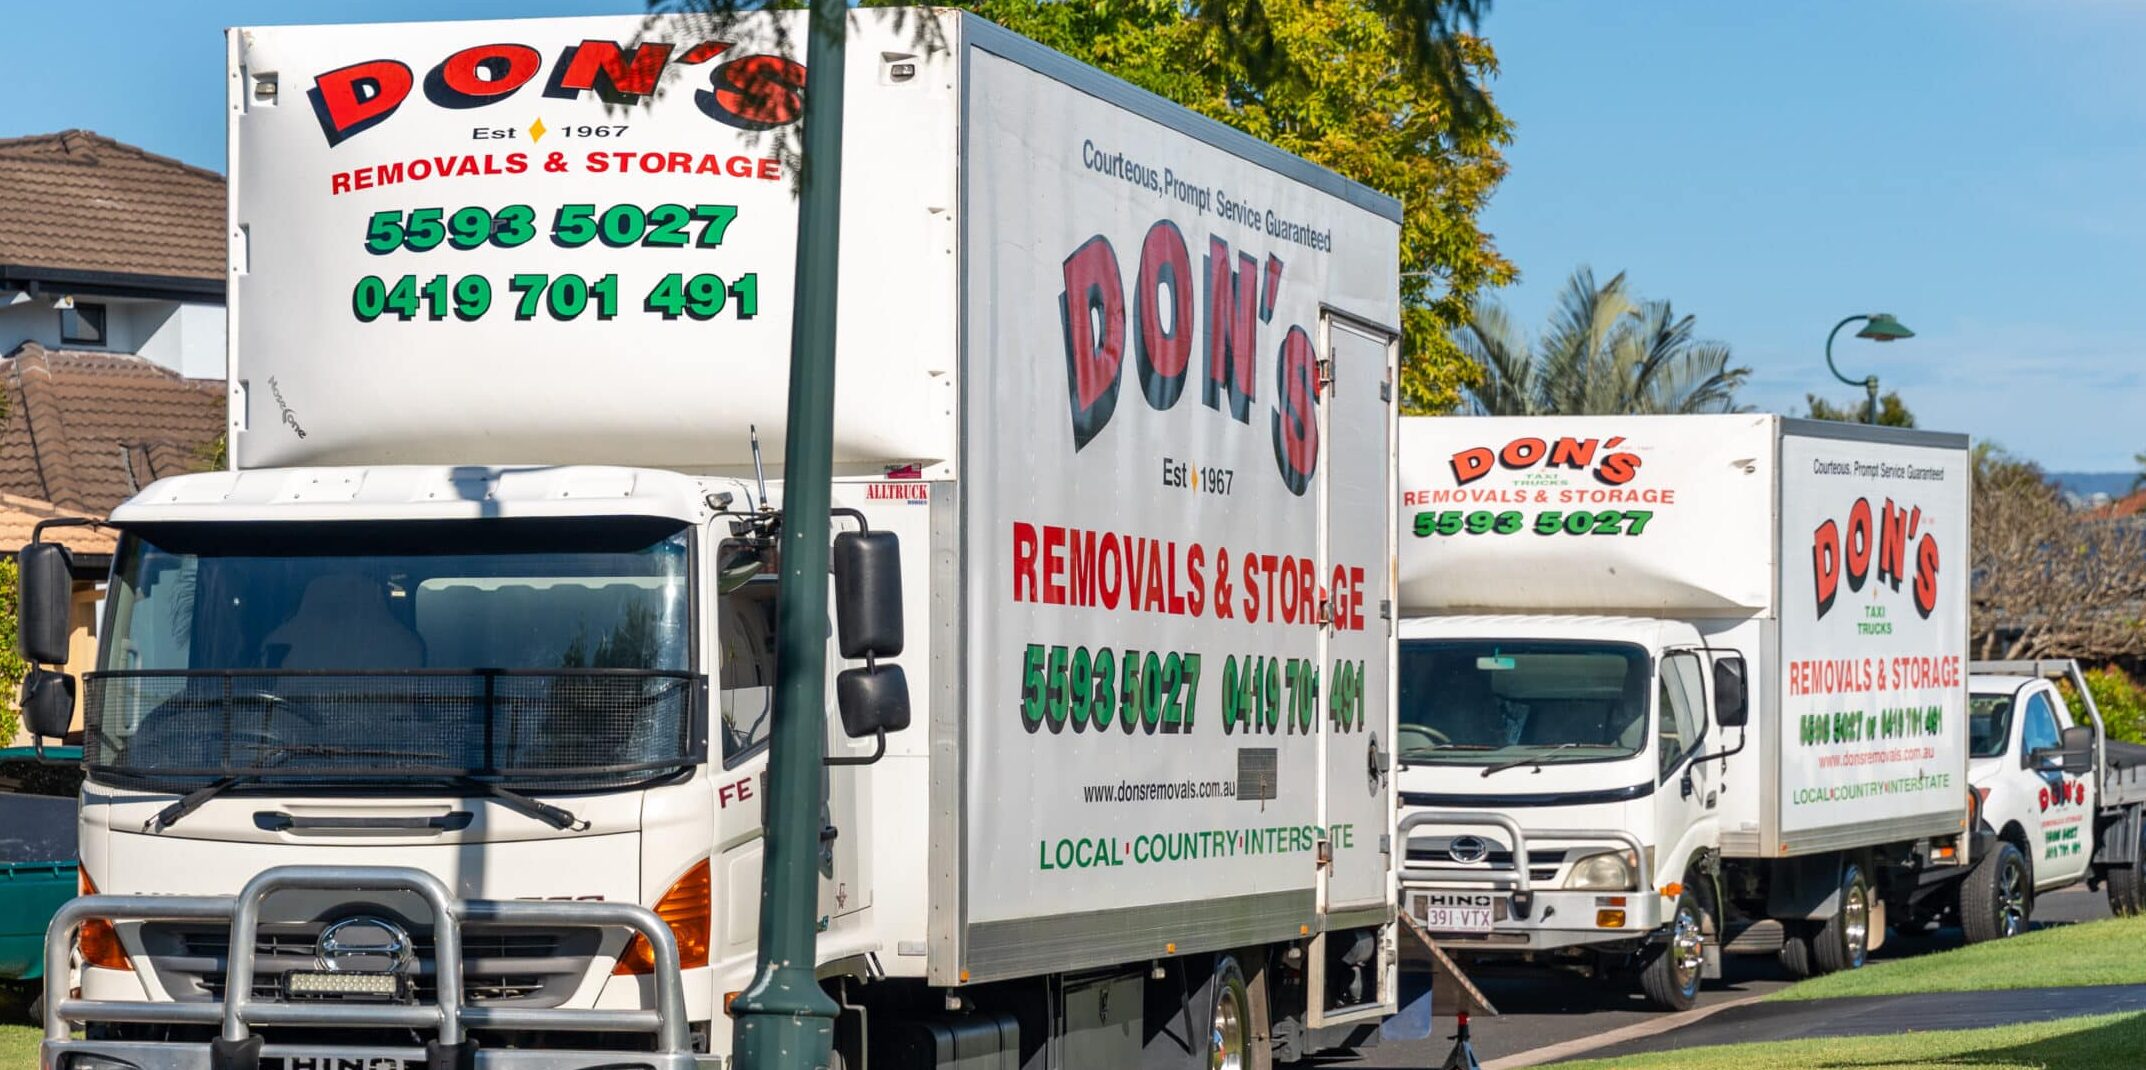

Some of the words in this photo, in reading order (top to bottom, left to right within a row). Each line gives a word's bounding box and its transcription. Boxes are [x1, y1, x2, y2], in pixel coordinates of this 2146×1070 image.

[306, 39, 806, 148] DON'S
[472, 126, 517, 140] Est
[560, 124, 629, 139] 1967
[332, 153, 528, 195] REMOVALS
[543, 151, 568, 173] &
[586, 151, 781, 181] STORAGE
[1164, 168, 1211, 215] Prompt
[1217, 190, 1261, 231] Service
[1265, 209, 1331, 253] Guaranteed
[365, 204, 536, 254] 5593
[550, 203, 738, 249] 5027
[352, 274, 491, 321] 0419
[509, 273, 618, 321] 701
[644, 272, 758, 321] 491
[1058, 219, 1319, 496] DON'S
[1163, 457, 1187, 489] Est
[1200, 466, 1233, 495] 1967
[1449, 436, 1642, 487] DON'S
[1854, 461, 1879, 480] Prompt
[1880, 463, 1905, 479] Service
[1907, 464, 1944, 481] Guaranteed
[866, 484, 928, 499] ALLTRUCK
[1404, 489, 1527, 506] REMOVALS
[1534, 490, 1548, 502] &
[1560, 489, 1674, 504] STORAGE
[1413, 511, 1523, 538] 5593
[1533, 510, 1653, 537] 5027
[1813, 496, 1940, 621] DON'S
[1013, 522, 1205, 617] REMOVALS
[1214, 547, 1234, 619] &
[1243, 552, 1364, 631] STORGE
[1858, 622, 1892, 635] TRUCKS
[1865, 606, 1885, 619] TAXI
[1020, 643, 1115, 734] 5593
[1120, 650, 1201, 735] 5027
[1222, 654, 1281, 736] 0419
[1329, 659, 1365, 734] 491
[1790, 658, 1872, 695] REMOVALS
[1877, 658, 1886, 691] &
[1892, 656, 1959, 689] STORAGE
[1819, 747, 1935, 769] www.donsremovals.com.au
[718, 776, 753, 809] FE
[1085, 779, 1236, 803] www.donsremovals.com.au
[1793, 786, 1830, 805] LOCAL
[1834, 780, 1884, 800] COUNTRY
[1888, 773, 1950, 794] INTERSTATE
[1040, 837, 1123, 870] LOCAL
[1134, 830, 1239, 864] COUNTRY
[1430, 910, 1452, 925] 391
[1461, 911, 1490, 926] VTX
[1431, 896, 1490, 906] HINO
